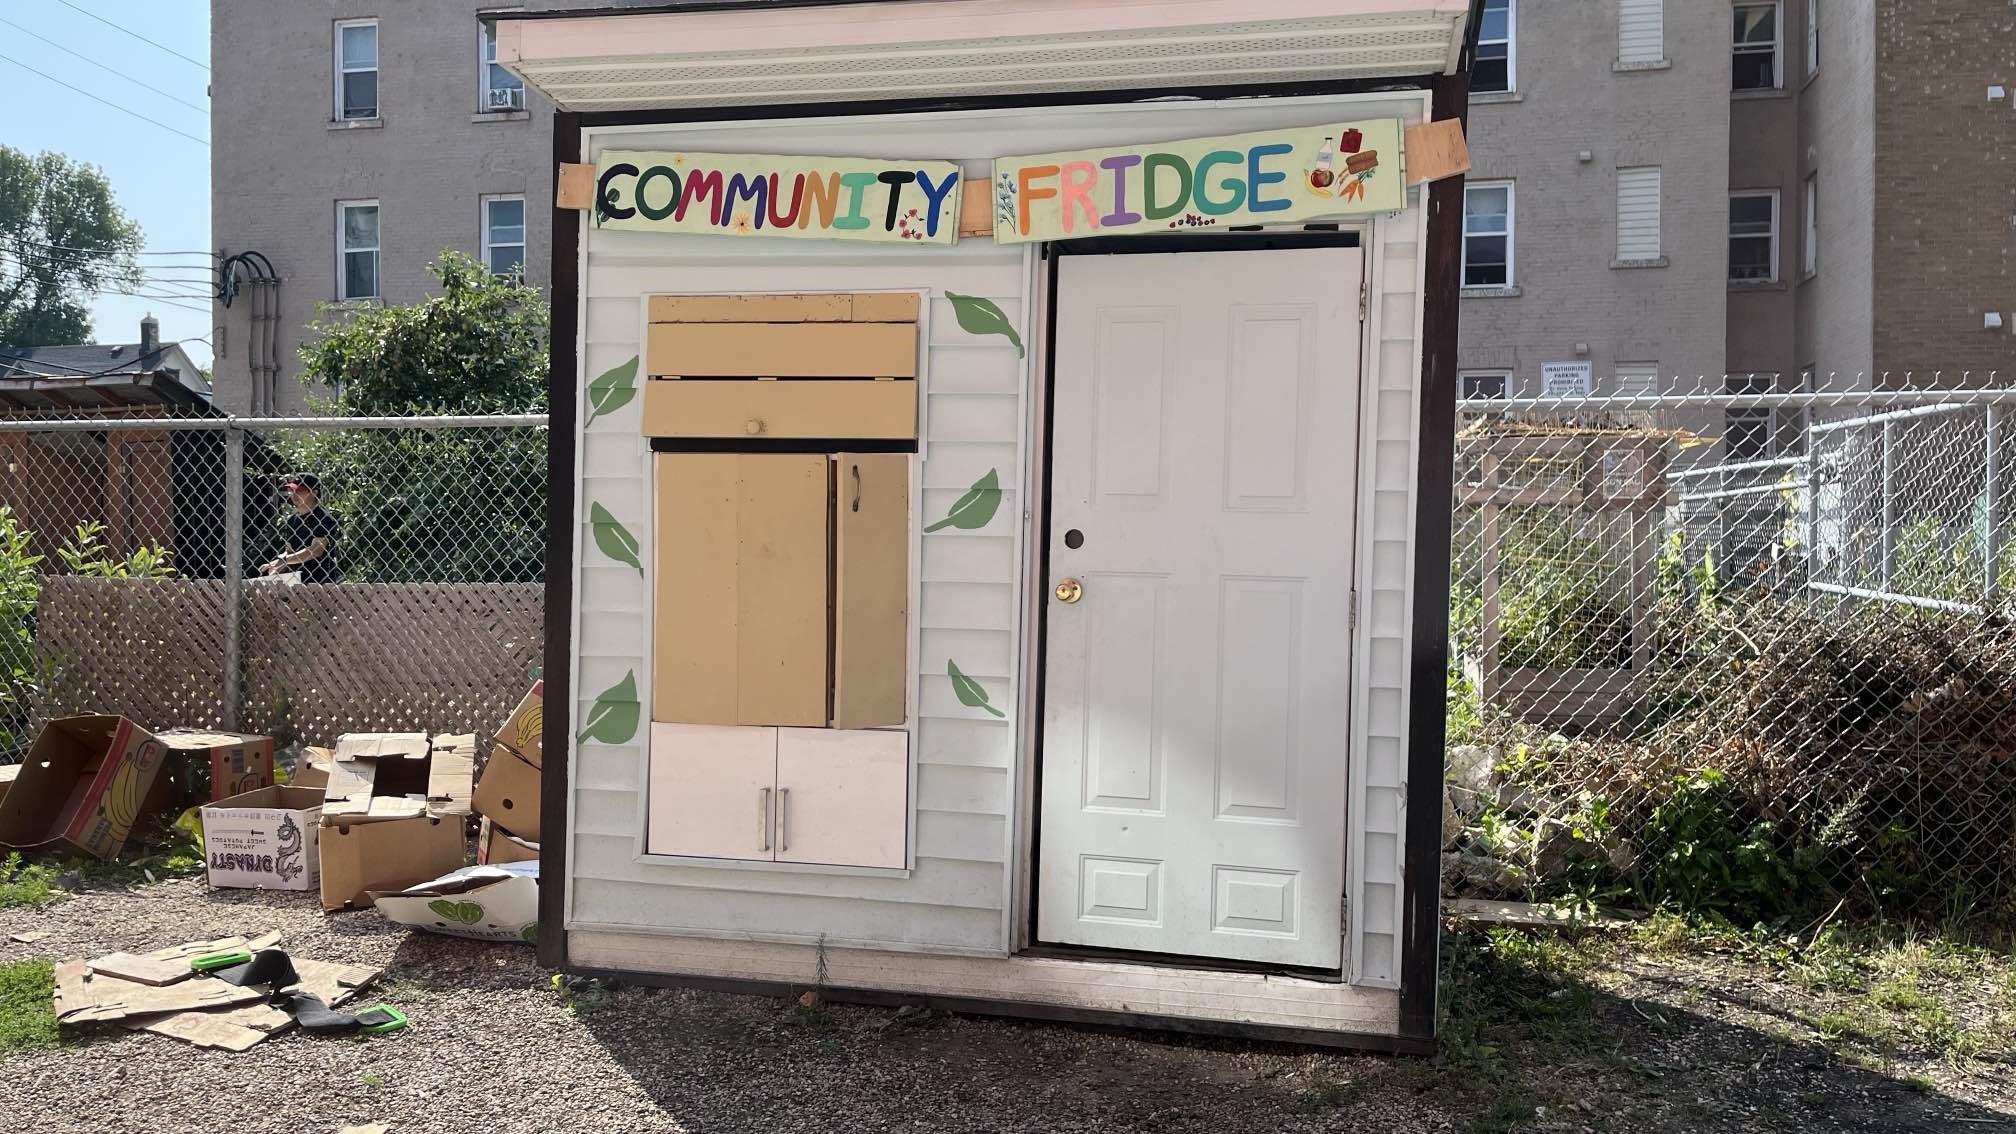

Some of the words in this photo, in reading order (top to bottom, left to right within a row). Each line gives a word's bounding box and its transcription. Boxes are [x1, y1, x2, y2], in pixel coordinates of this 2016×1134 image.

[597, 163, 958, 237] COMMUNITY
[1018, 143, 1293, 236] FRIDGE
[210, 852, 274, 873] DYNASTY
